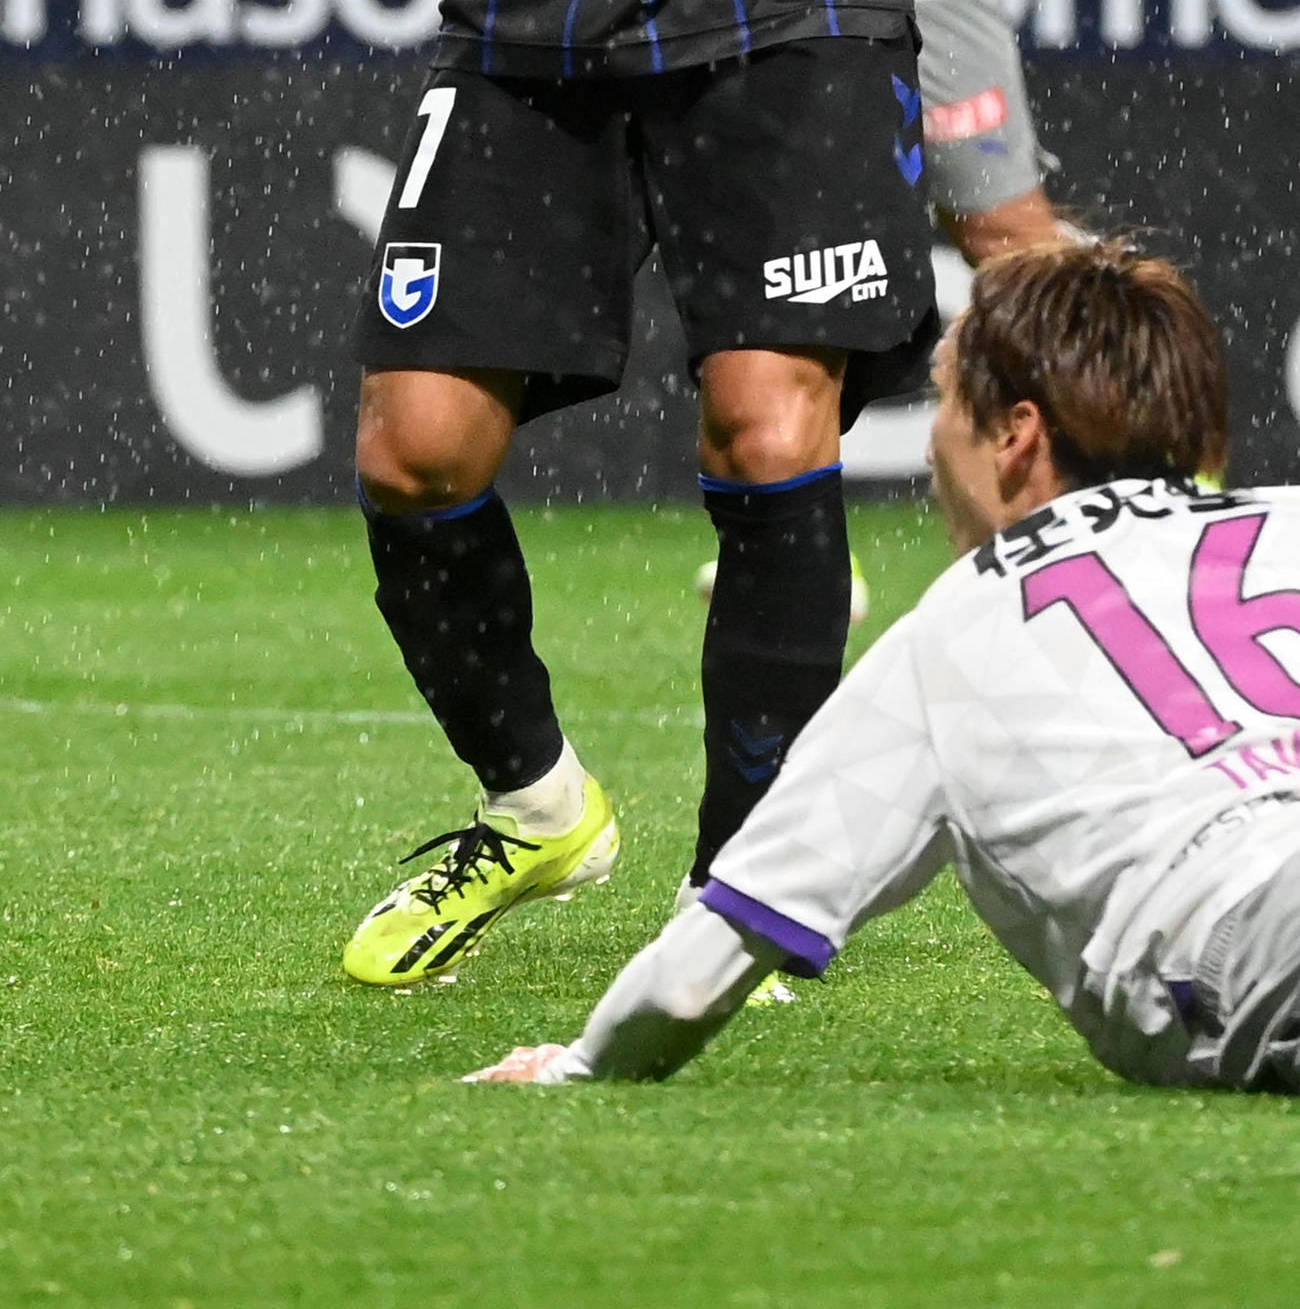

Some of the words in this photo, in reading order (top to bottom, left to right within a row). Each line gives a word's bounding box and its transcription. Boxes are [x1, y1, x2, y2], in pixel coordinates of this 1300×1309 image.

[763, 239, 888, 302] SUITA
[852, 279, 889, 303] CITY
[1020, 510, 1300, 760] 16
